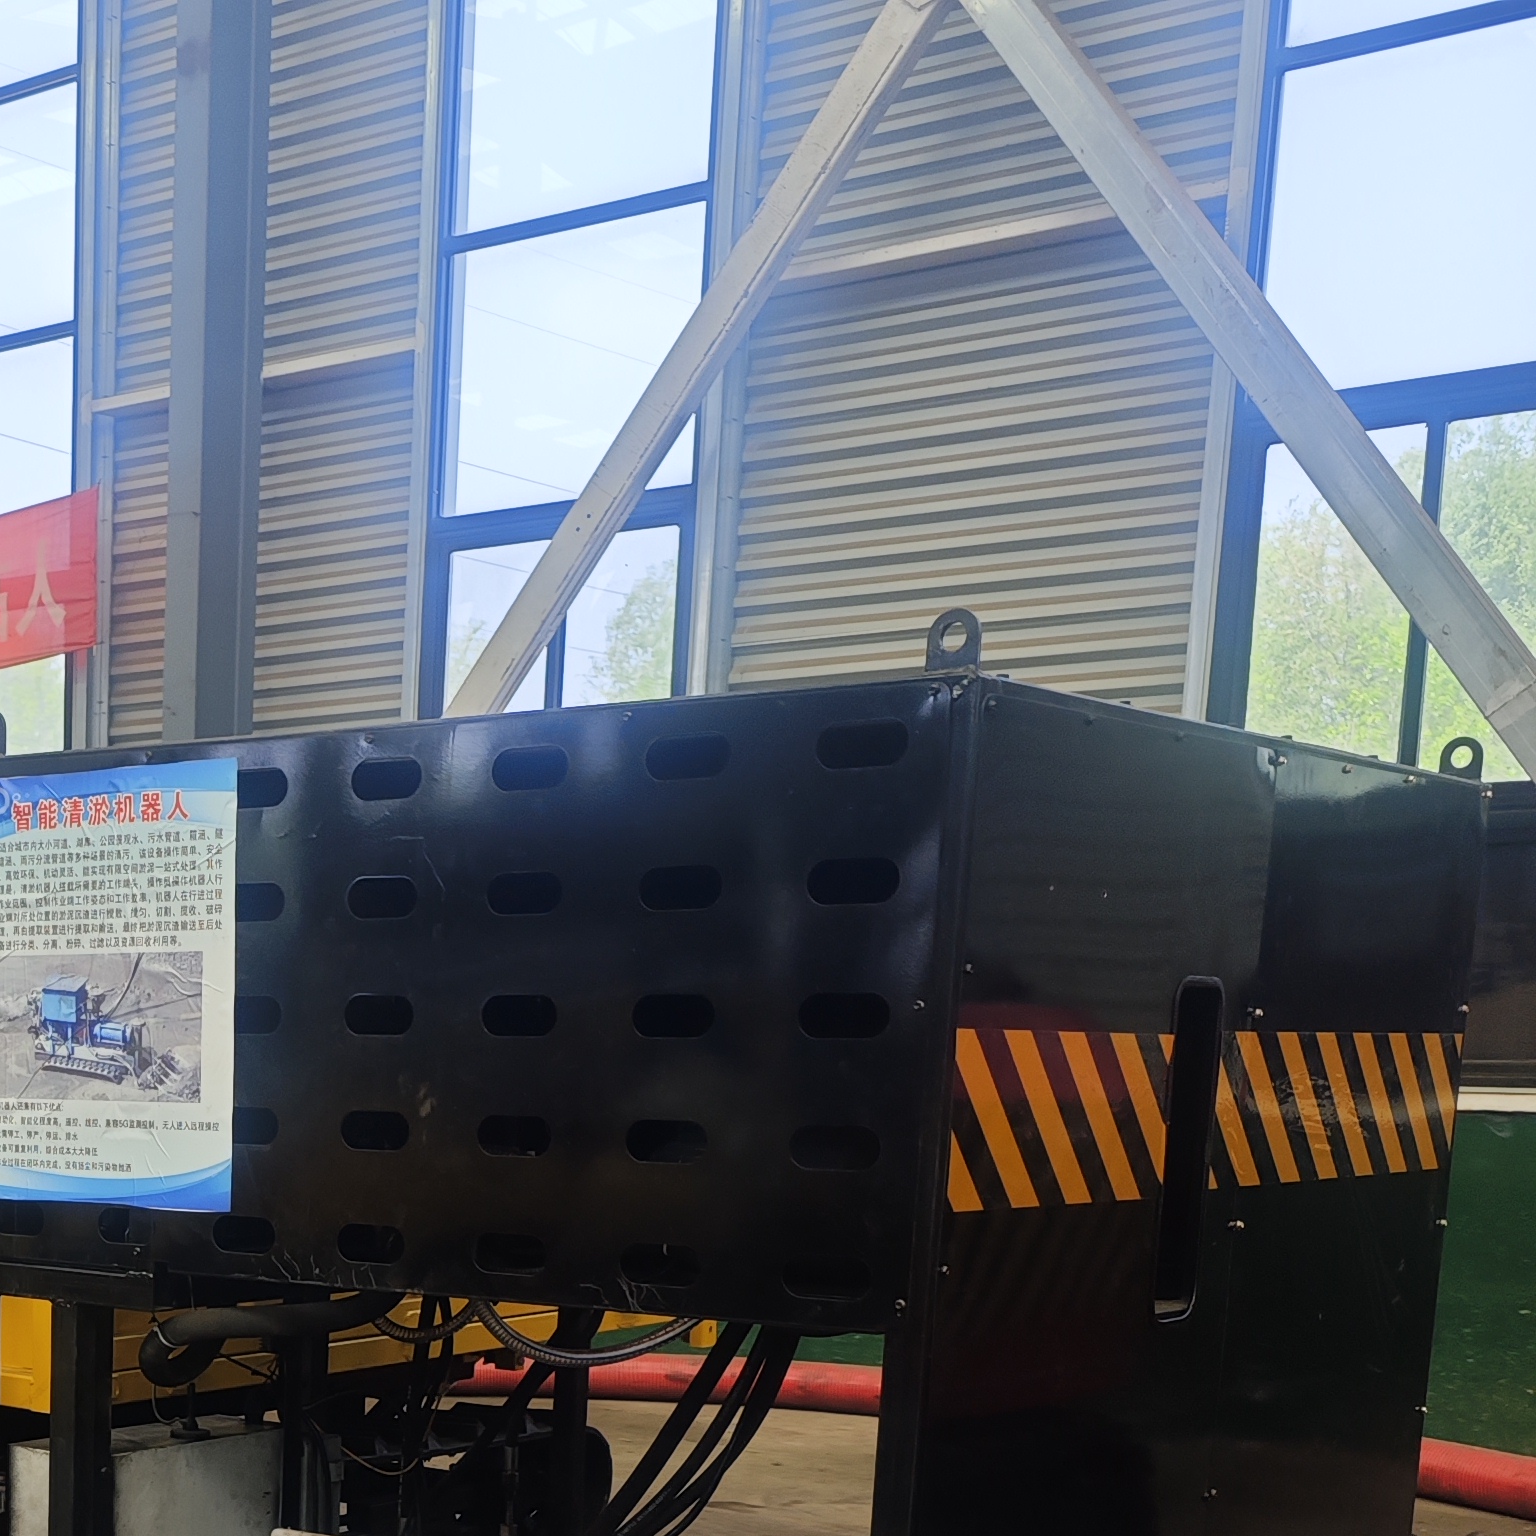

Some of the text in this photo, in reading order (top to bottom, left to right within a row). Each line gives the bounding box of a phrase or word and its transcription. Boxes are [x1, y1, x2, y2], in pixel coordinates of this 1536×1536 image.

[13, 790, 190, 832] 智能清淤机器人
